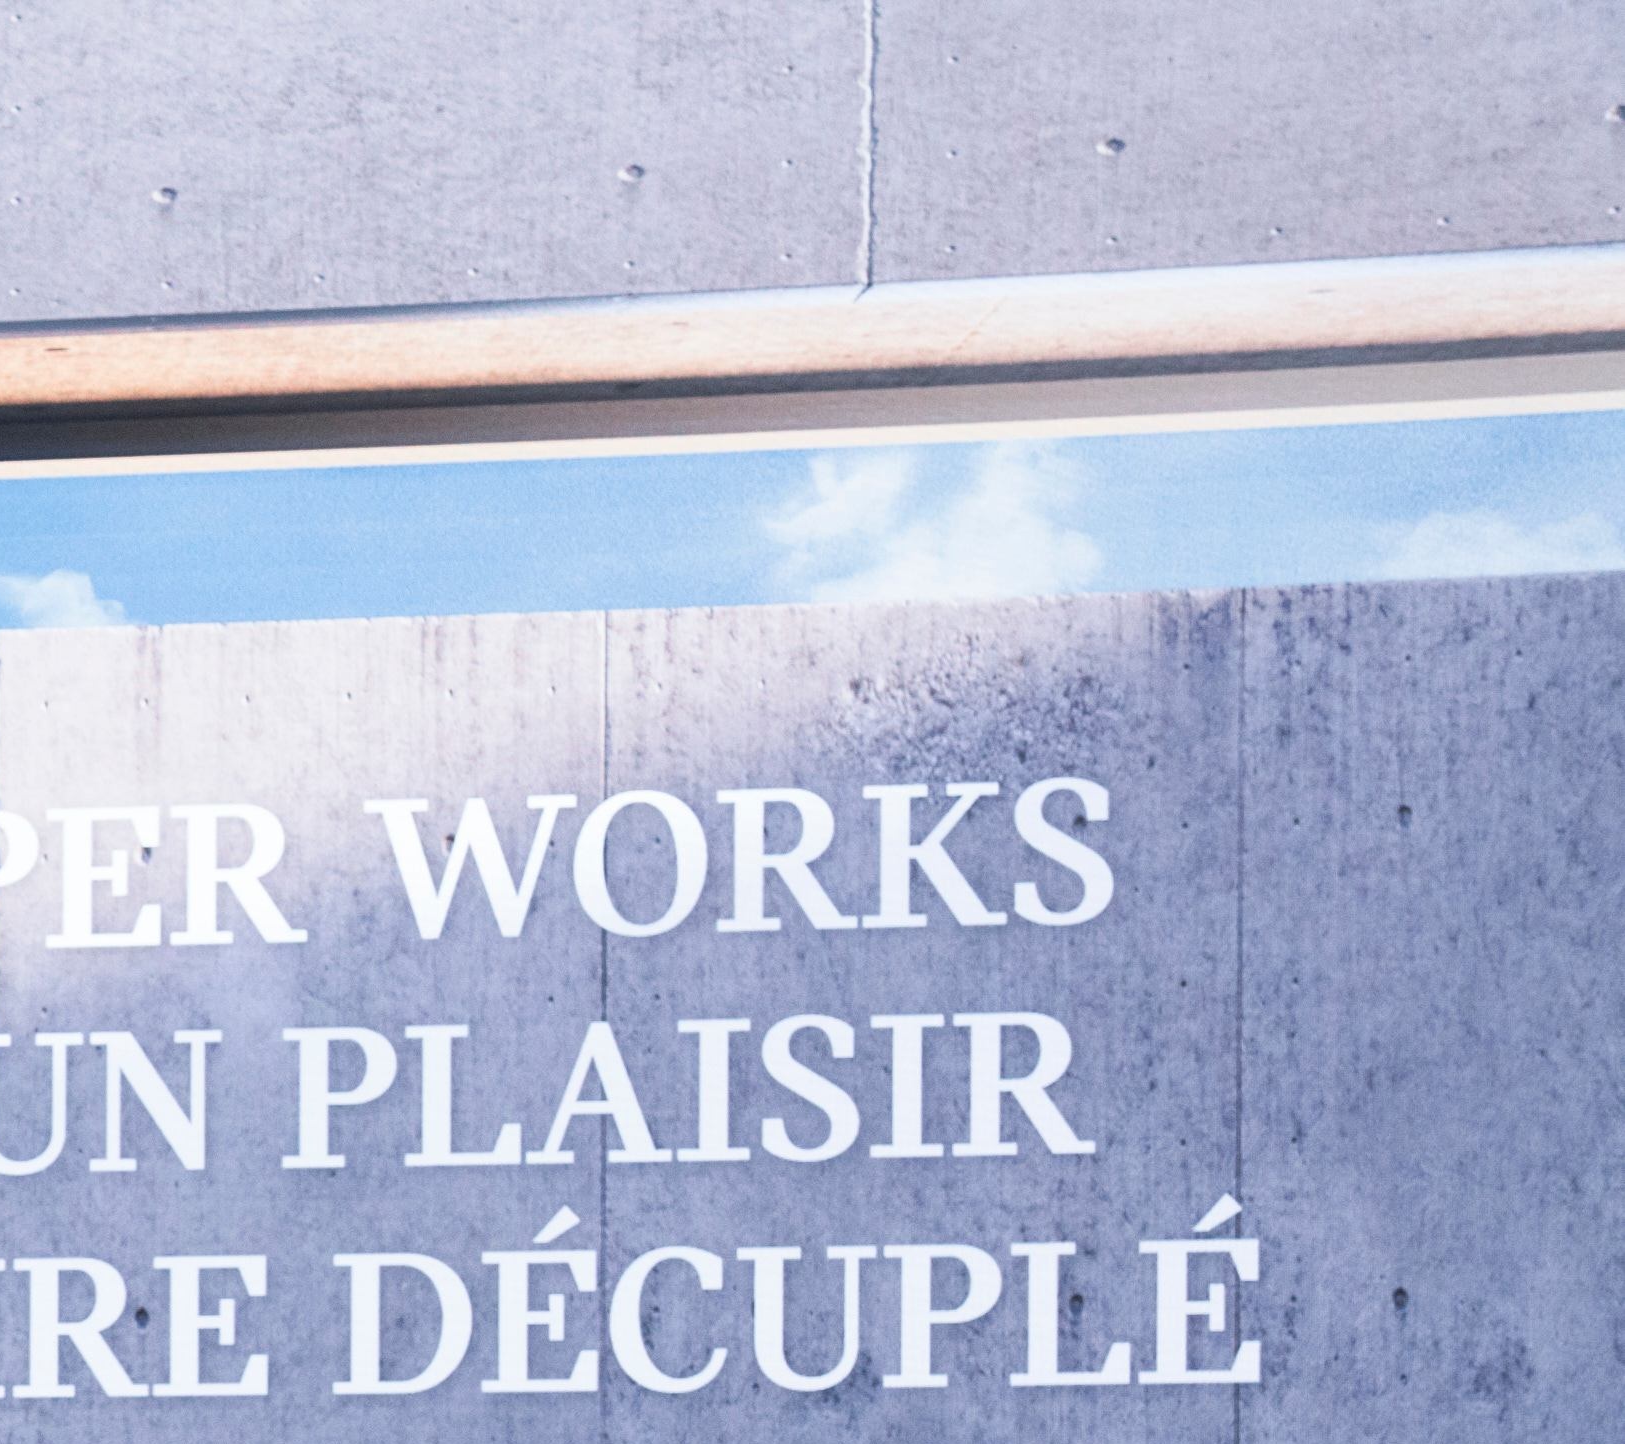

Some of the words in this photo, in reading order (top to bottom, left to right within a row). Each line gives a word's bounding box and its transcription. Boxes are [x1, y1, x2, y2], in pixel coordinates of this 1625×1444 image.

[364, 774, 1117, 942] WORKS
[281, 1010, 1097, 1170] PLAISIR
[331, 1191, 1262, 1396] DÉCUPLÉ
